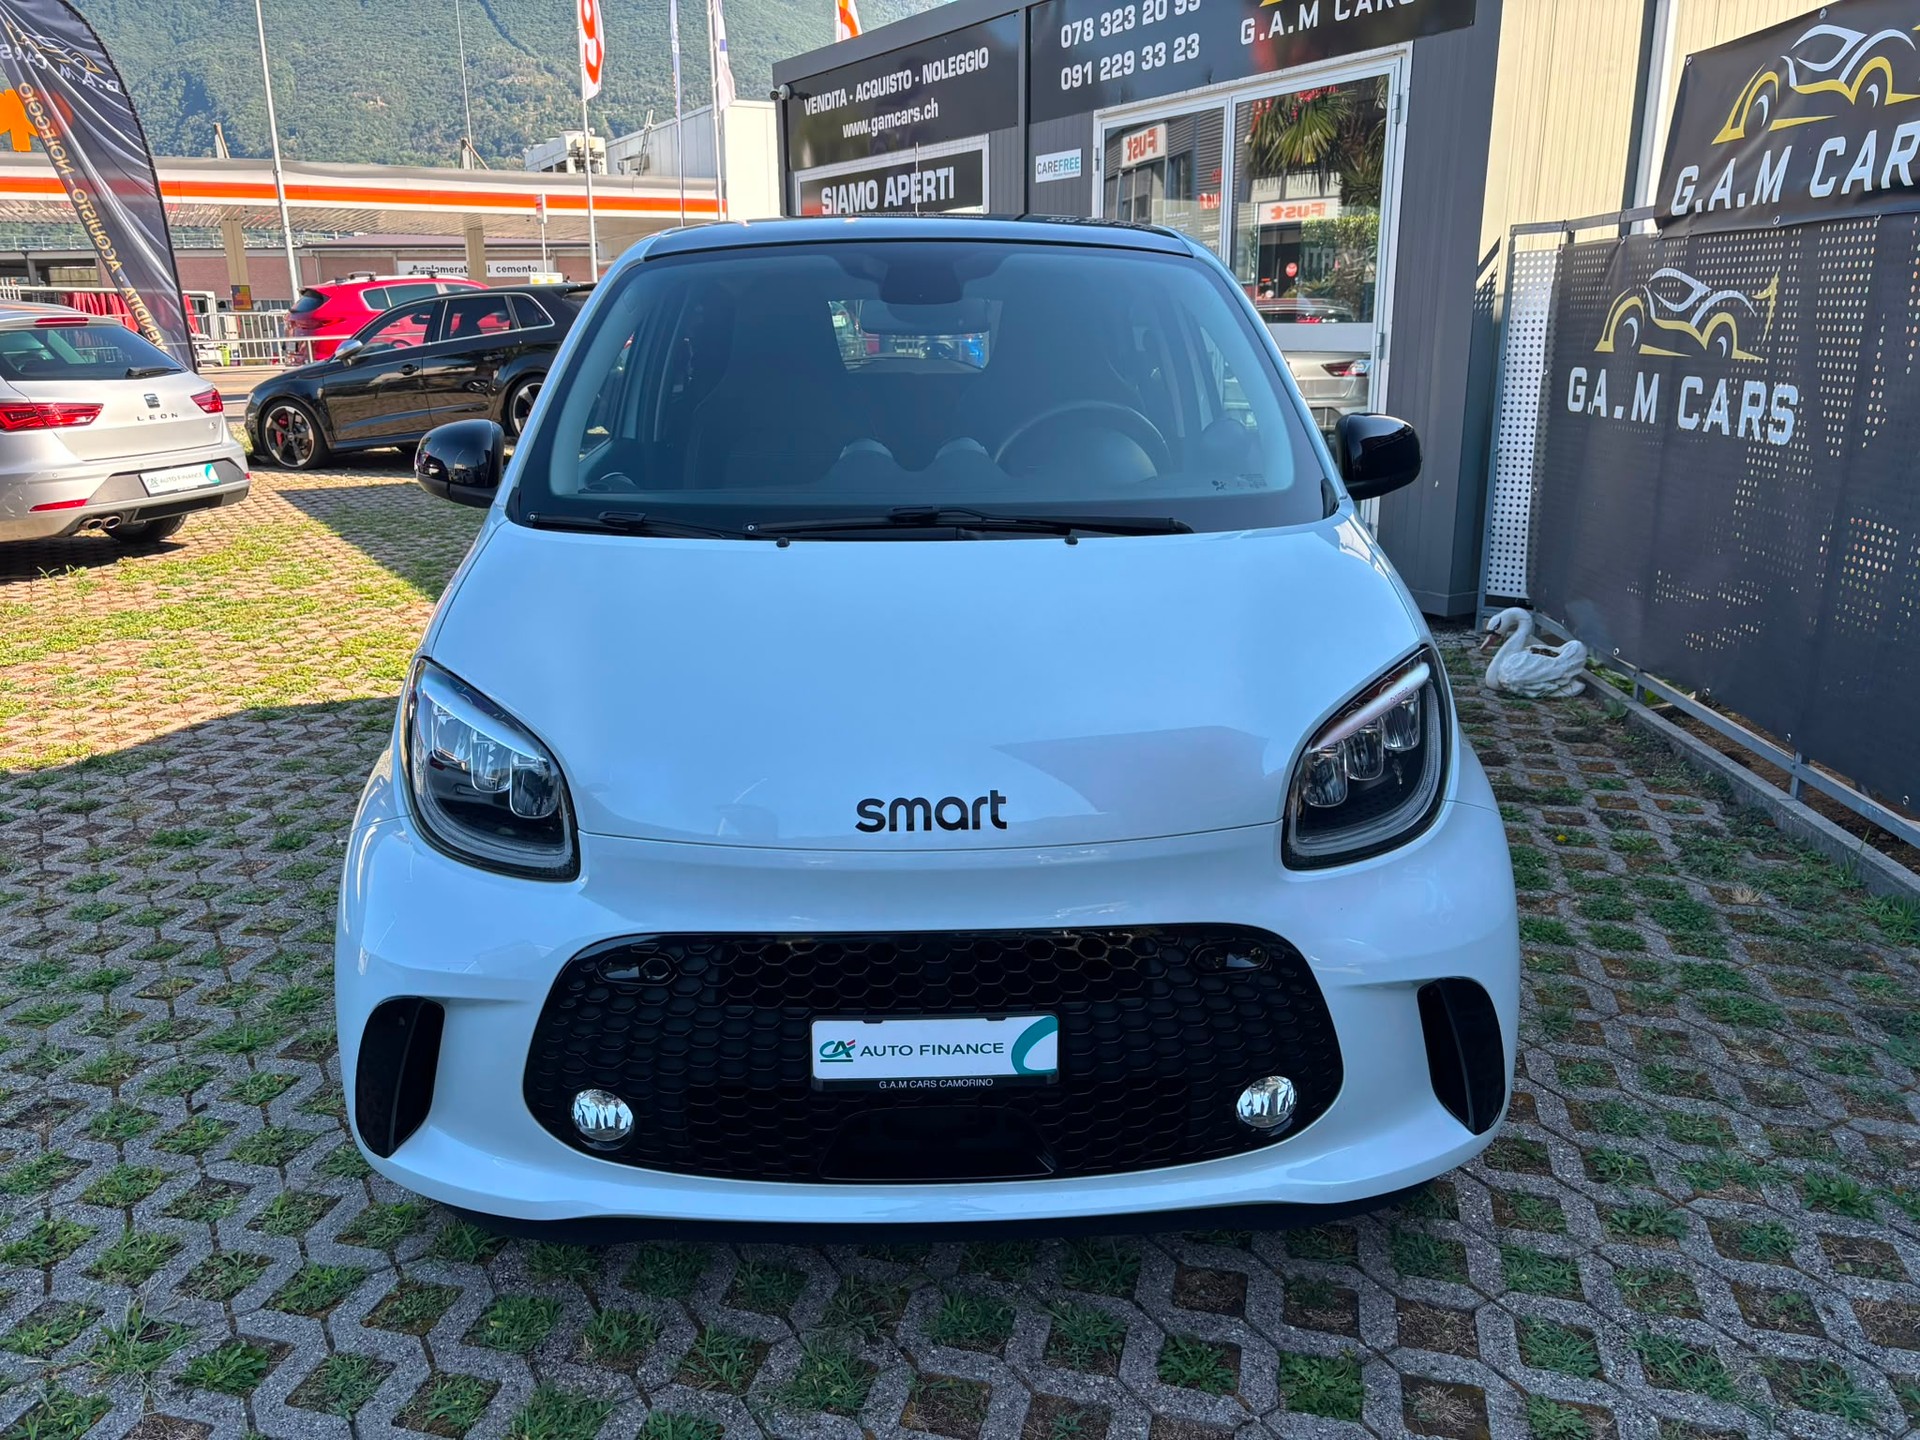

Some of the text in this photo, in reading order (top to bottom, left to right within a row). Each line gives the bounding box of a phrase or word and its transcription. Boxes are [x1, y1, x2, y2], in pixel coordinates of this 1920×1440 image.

[1061, 17, 1094, 48] 078
[1100, 4, 1135, 37] 323
[1142, 0, 1168, 26] 20
[1240, 0, 1415, 45] G.A.M CA
[804, 88, 848, 116] VENDITA
[855, 69, 912, 103] ACQUISTO
[922, 47, 989, 85] NOLEGGIO
[1061, 32, 1200, 90] 091 229 33 23
[842, 98, 939, 139] www.gamcars.ch
[1036, 157, 1080, 175] CAREFREE
[1671, 146, 1793, 216] G.A.M
[821, 167, 955, 215] SIAMO APERTI
[496, 264, 538, 273] cemento
[137, 412, 178, 421] LEON
[1677, 376, 1799, 445] CARS
[855, 789, 1008, 833] smart
[860, 1044, 913, 1057] AUTO
[919, 1042, 1005, 1056] FINANCE
[879, 1078, 994, 1089] G.A.M CARS CAMORINO
